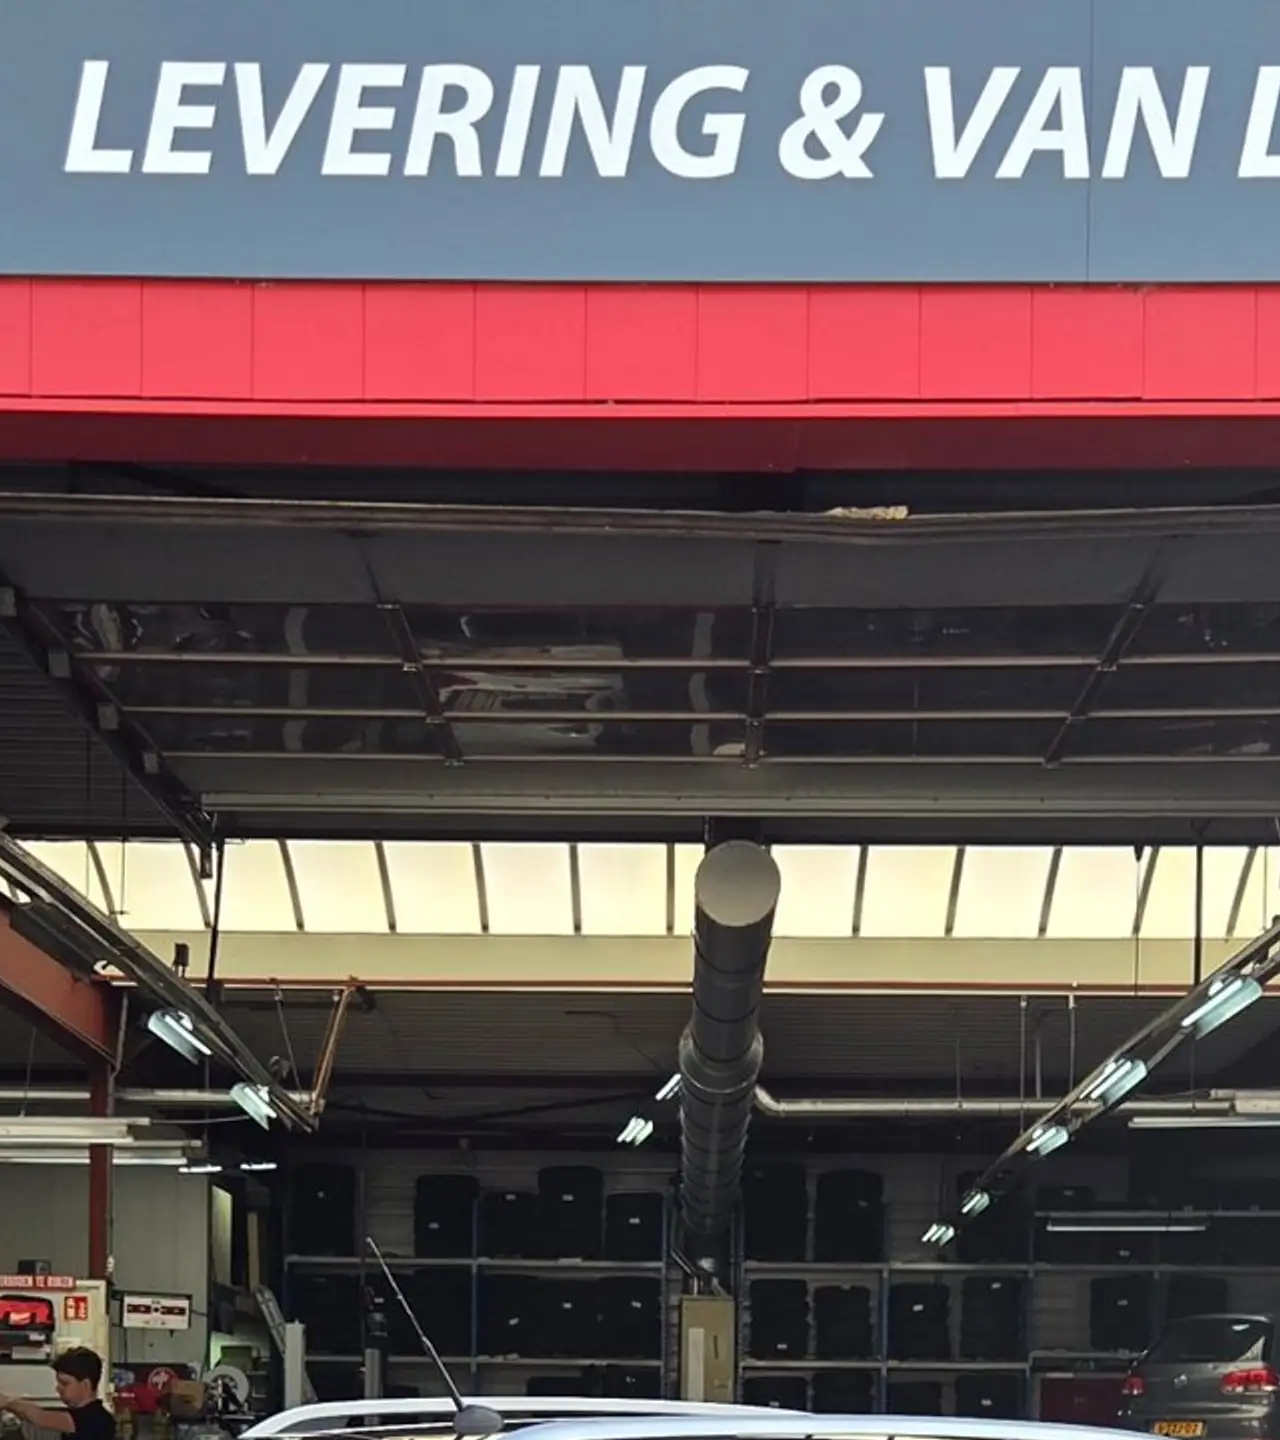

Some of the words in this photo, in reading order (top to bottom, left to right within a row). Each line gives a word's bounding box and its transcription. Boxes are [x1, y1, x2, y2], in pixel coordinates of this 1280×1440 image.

[63, 59, 750, 179] LEVERING
[778, 64, 886, 180] &
[923, 66, 1211, 179] VAN
